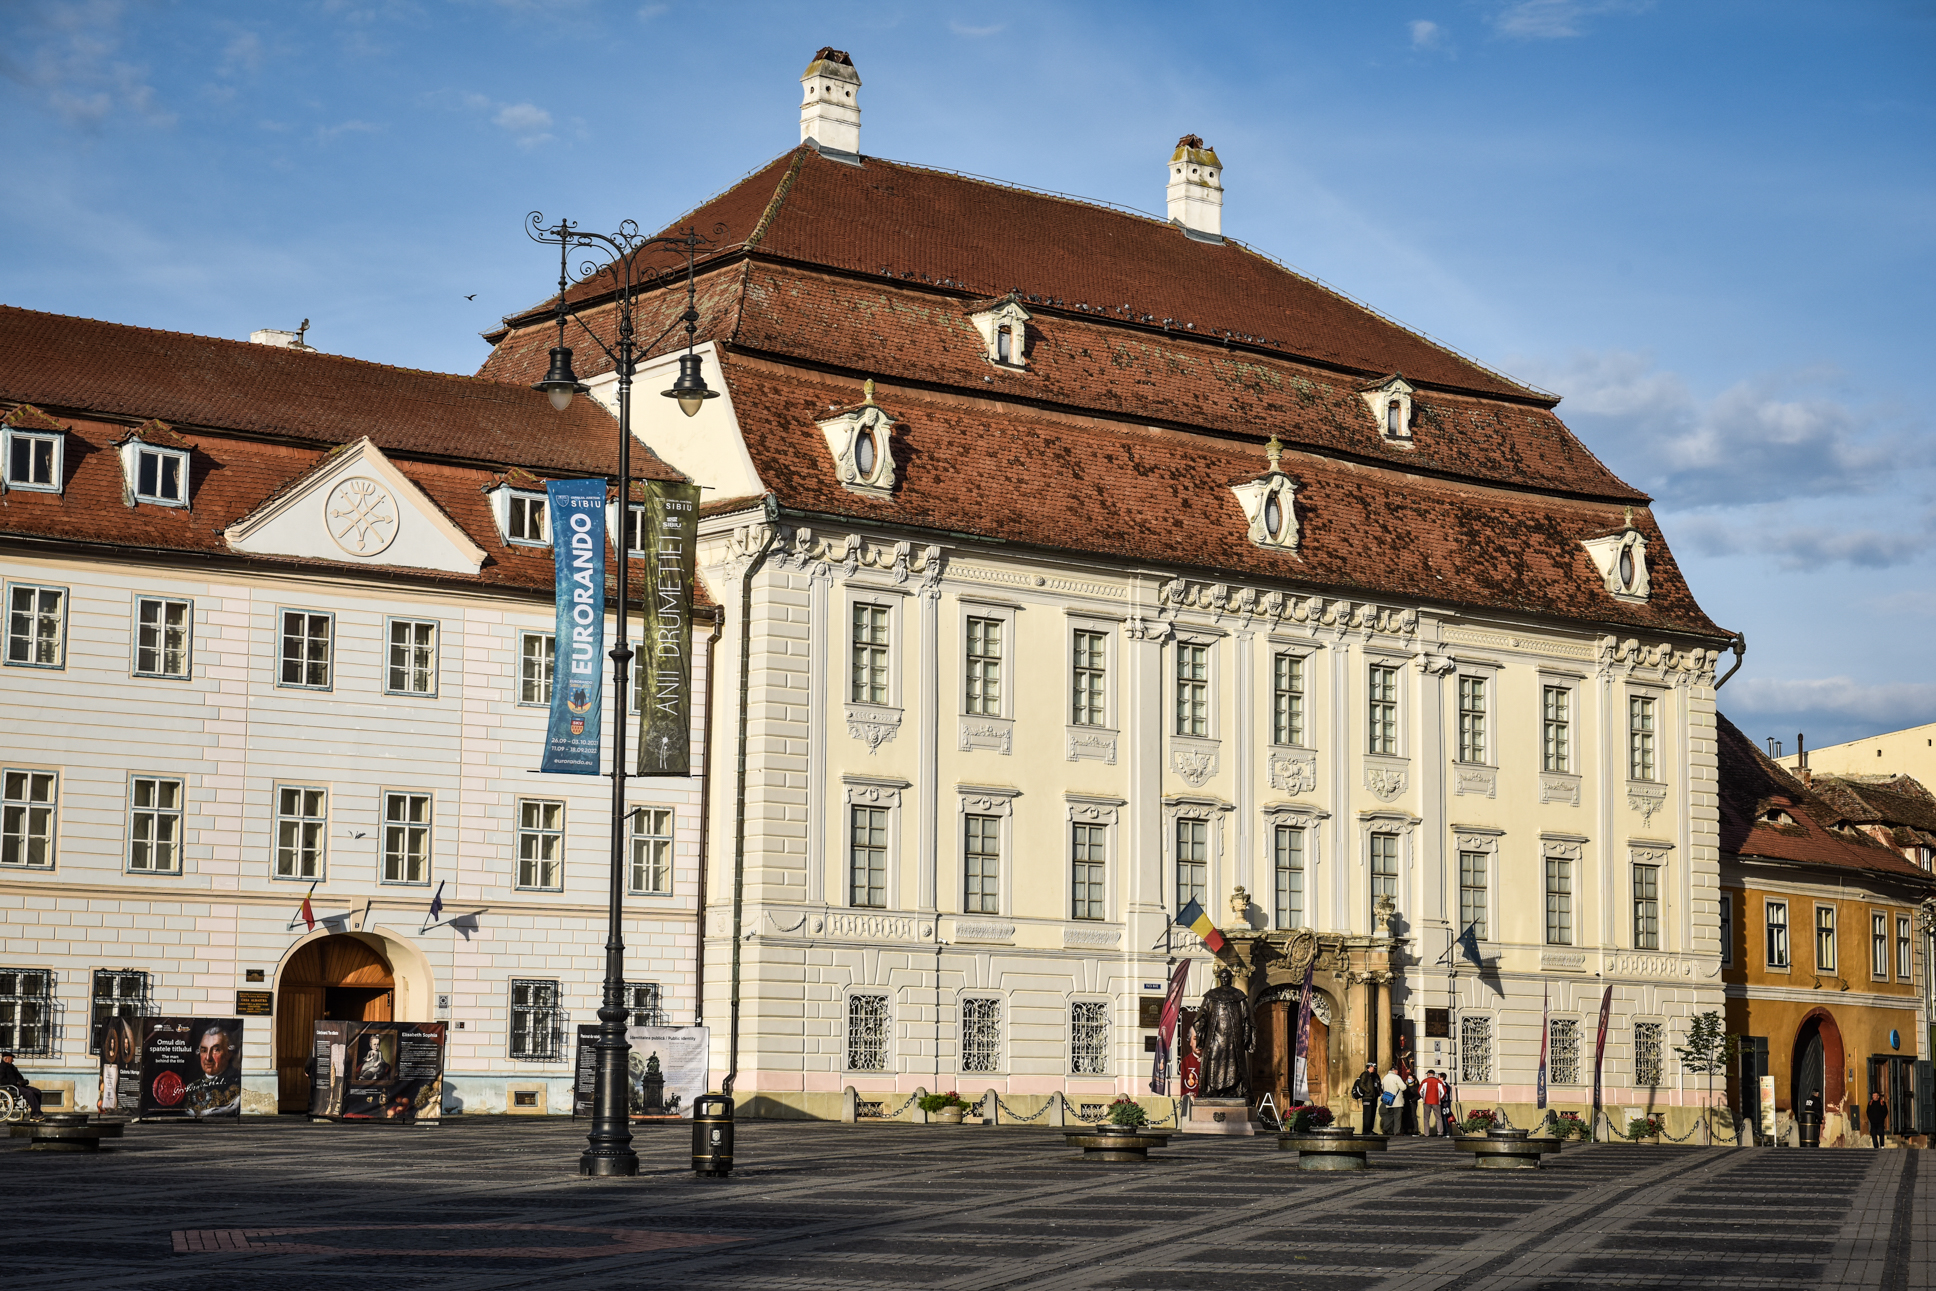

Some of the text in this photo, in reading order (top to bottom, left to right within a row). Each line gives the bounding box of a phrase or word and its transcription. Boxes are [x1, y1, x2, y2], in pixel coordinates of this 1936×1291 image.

[571, 500, 601, 508] SIBIU
[666, 503, 692, 511] SIBIU
[570, 513, 595, 675] EURORANDO
